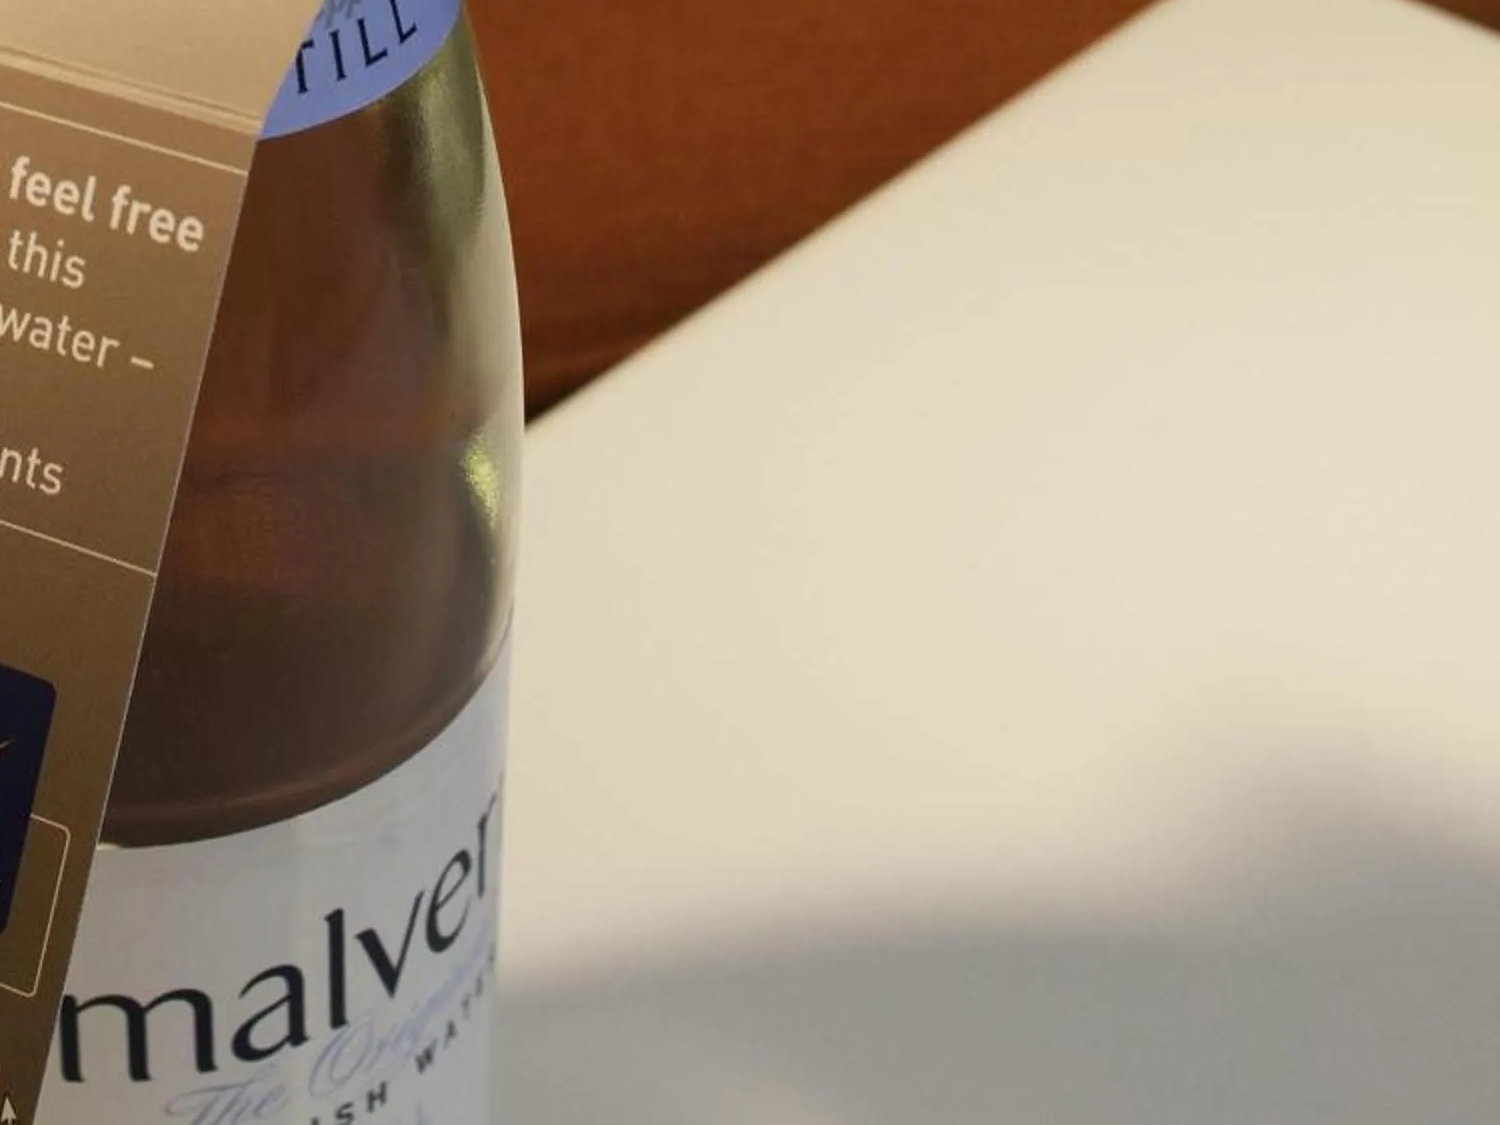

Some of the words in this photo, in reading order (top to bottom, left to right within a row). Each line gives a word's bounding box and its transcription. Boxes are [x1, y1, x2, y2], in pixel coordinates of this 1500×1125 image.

[8, 156, 98, 222] feel
[109, 185, 205, 252] free
[8, 231, 88, 289] this
